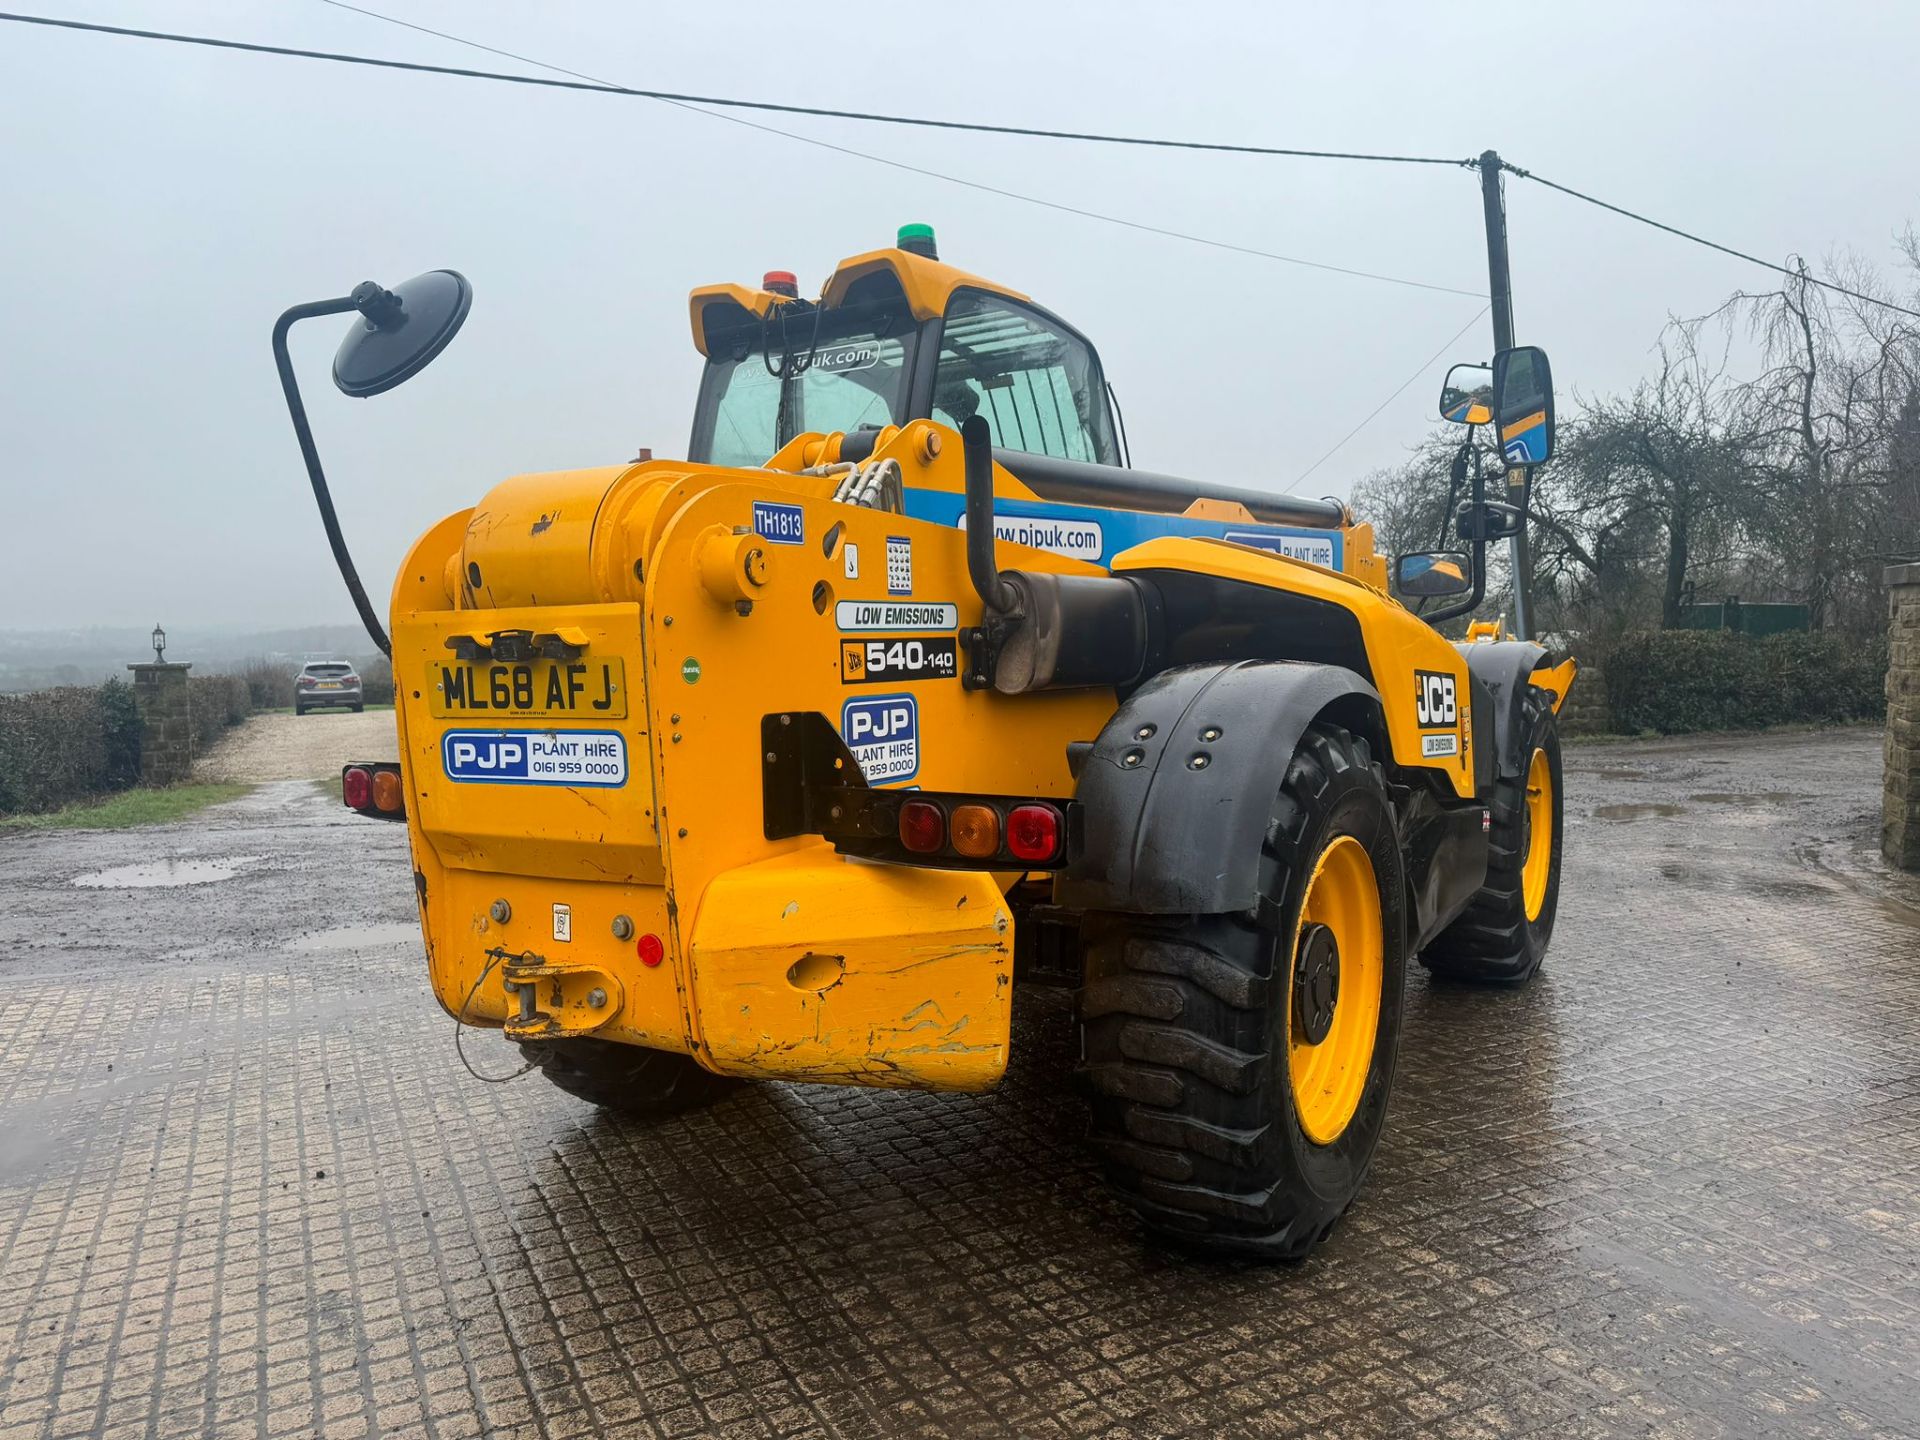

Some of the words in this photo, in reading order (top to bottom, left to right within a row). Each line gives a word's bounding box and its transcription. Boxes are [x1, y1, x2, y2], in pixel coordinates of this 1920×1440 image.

[755, 509, 802, 537] TH1813
[1284, 546, 1310, 561] PLANT
[1312, 548, 1329, 563] HIRE
[855, 606, 881, 625] LOW
[884, 607, 945, 625] EMISSIONS
[442, 666, 533, 710] ML68
[1417, 676, 1456, 723] JCB
[851, 708, 909, 740] PJP
[454, 743, 522, 768] PJP
[532, 743, 579, 757] PLANT
[584, 743, 617, 757] HIRE
[889, 743, 914, 758] HIRE
[533, 762, 556, 772] 0161
[559, 763, 582, 773] 959
[585, 763, 619, 775] 0000
[870, 763, 887, 776] 959
[889, 759, 913, 773] 0000
